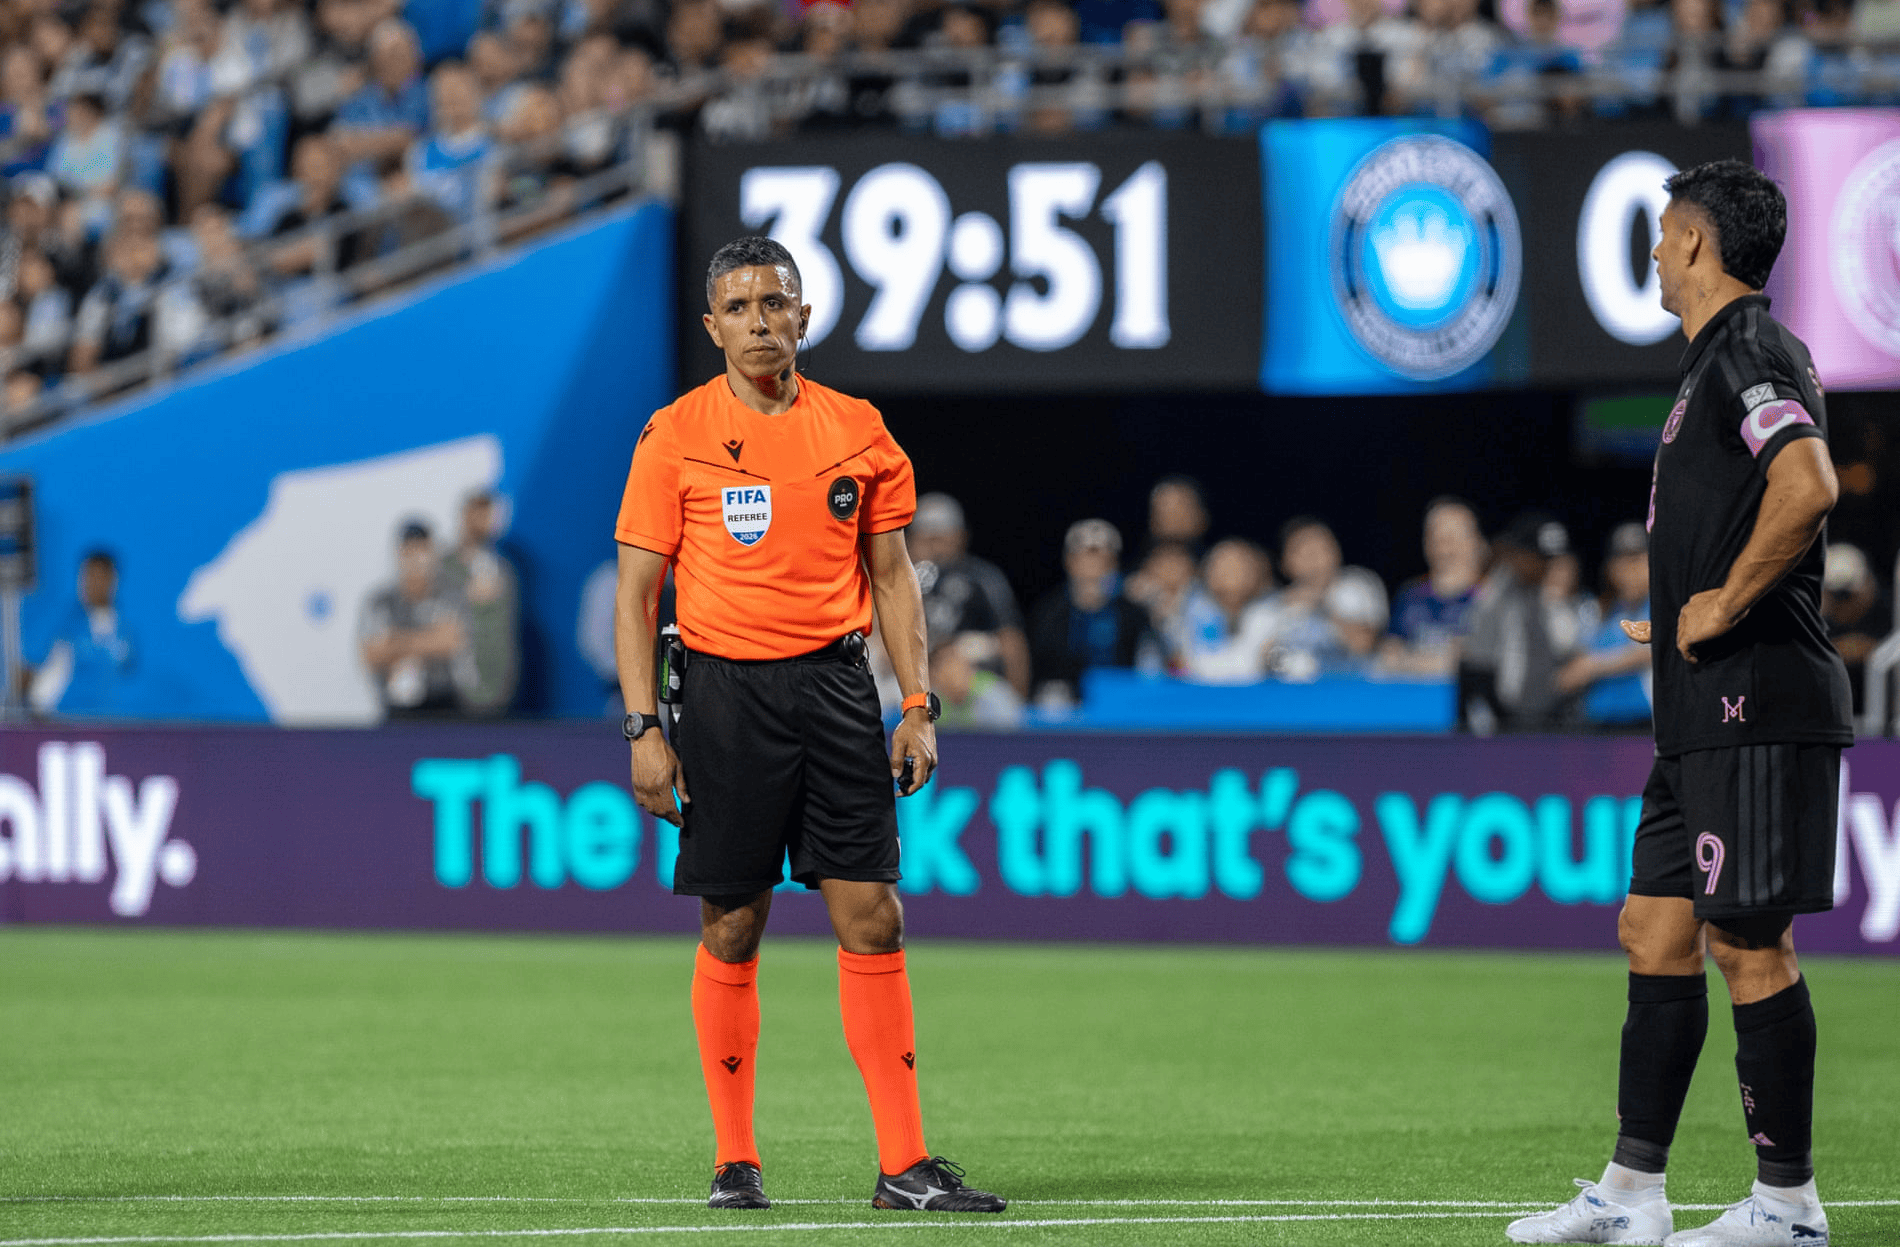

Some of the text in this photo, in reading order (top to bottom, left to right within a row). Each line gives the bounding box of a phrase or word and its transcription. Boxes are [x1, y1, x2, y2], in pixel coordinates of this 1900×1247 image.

[740, 161, 1170, 352] 39:51
[1577, 150, 1683, 346] 0
[1750, 400, 1797, 440] C
[726, 489, 766, 505] FIFA
[727, 512, 768, 522] REFEREE
[834, 492, 853, 504] PRO
[1721, 695, 1746, 723] M
[411, 754, 641, 890] The
[990, 758, 1362, 900] that's
[1695, 831, 1726, 895] 9
